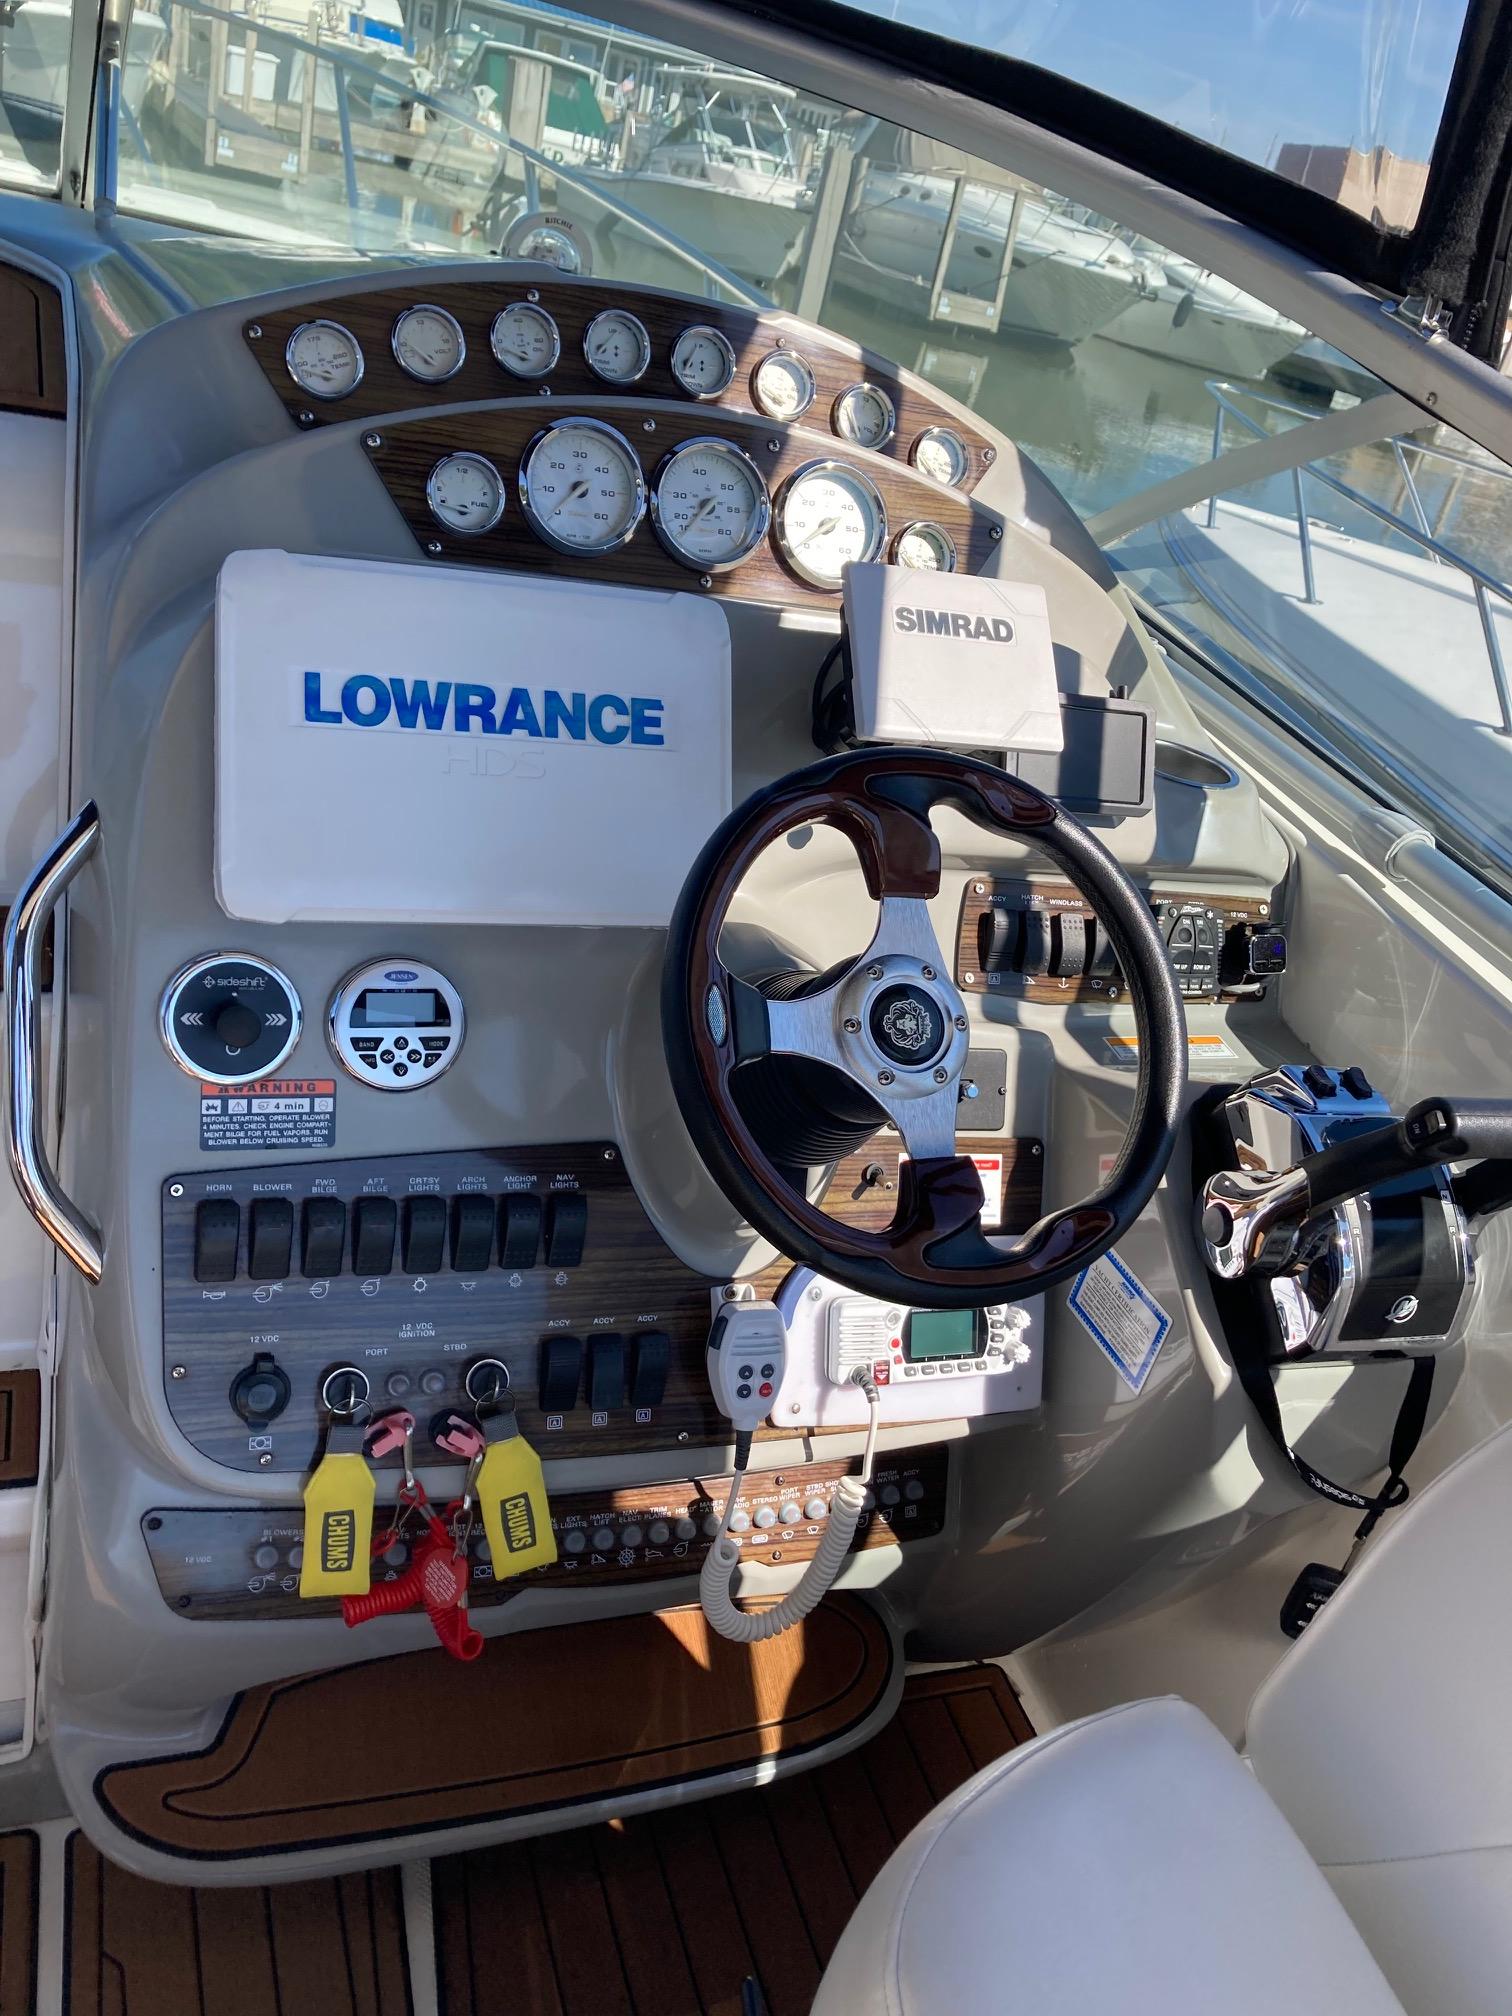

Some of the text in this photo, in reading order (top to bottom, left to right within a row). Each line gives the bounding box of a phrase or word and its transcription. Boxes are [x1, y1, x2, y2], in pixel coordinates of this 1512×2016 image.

[545, 217, 573, 230] RITCHIE
[572, 450, 588, 459] 30
[550, 461, 565, 470] 20
[594, 465, 609, 474] 40
[693, 468, 707, 476] 40
[542, 485, 555, 493] 10
[720, 483, 735, 491] 50
[601, 489, 615, 498] 50
[673, 491, 687, 499] 30
[823, 489, 835, 497] 30
[802, 499, 815, 507] 20
[727, 506, 740, 514] 55
[594, 513, 608, 521] 60
[674, 512, 688, 520] 20
[718, 528, 732, 536] 60
[845, 525, 858, 533] 50
[895, 607, 1014, 642] SIMRAD
[303, 671, 665, 746] LOWRANCE
[443, 745, 546, 780] HDS
[1049, 899, 1083, 907] WINDLASS
[217, 977, 265, 987] sideshift
[274, 1102, 304, 1110] 4 min
[315, 1178, 336, 1186] FWD
[367, 1177, 385, 1185] AFT
[503, 1175, 538, 1183] ANCHOR
[206, 1184, 232, 1192] HORN
[252, 1183, 293, 1191] BLOWER
[311, 1185, 338, 1193] BILGE
[362, 1185, 389, 1193] BILGE
[408, 1184, 440, 1192] LIGHTS
[457, 1183, 488, 1191] LIGHTS
[507, 1182, 532, 1190] LIGHT
[550, 1181, 579, 1189] LIGHTS
[1094, 1264, 1112, 1287] YACHT
[1111, 1285, 1150, 1335] CERTIFICATION
[593, 1316, 615, 1325] ACCY
[637, 1314, 658, 1323] ACCY
[415, 1322, 433, 1330] VDC
[548, 1319, 571, 1327] ACCY
[398, 1330, 436, 1338] IGNITION
[261, 1335, 279, 1343] VDC
[443, 1343, 467, 1352] STBD
[365, 1348, 388, 1356] PORT
[876, 1475, 900, 1484] WATER
[780, 1486, 799, 1494] PORT
[806, 1483, 824, 1491] STBD
[805, 1488, 826, 1497] WIPER
[700, 1499, 724, 1508] MACER
[752, 1496, 778, 1504] STEREO
[732, 1501, 750, 1509] ADIO
[590, 1513, 616, 1521] HATCH
[618, 1515, 642, 1523] ELECT
[644, 1511, 672, 1520] PLANES
[505, 1497, 532, 1550] CHUMS
[560, 1521, 588, 1529] LIGHTS
[326, 1514, 350, 1570] CHUMS
